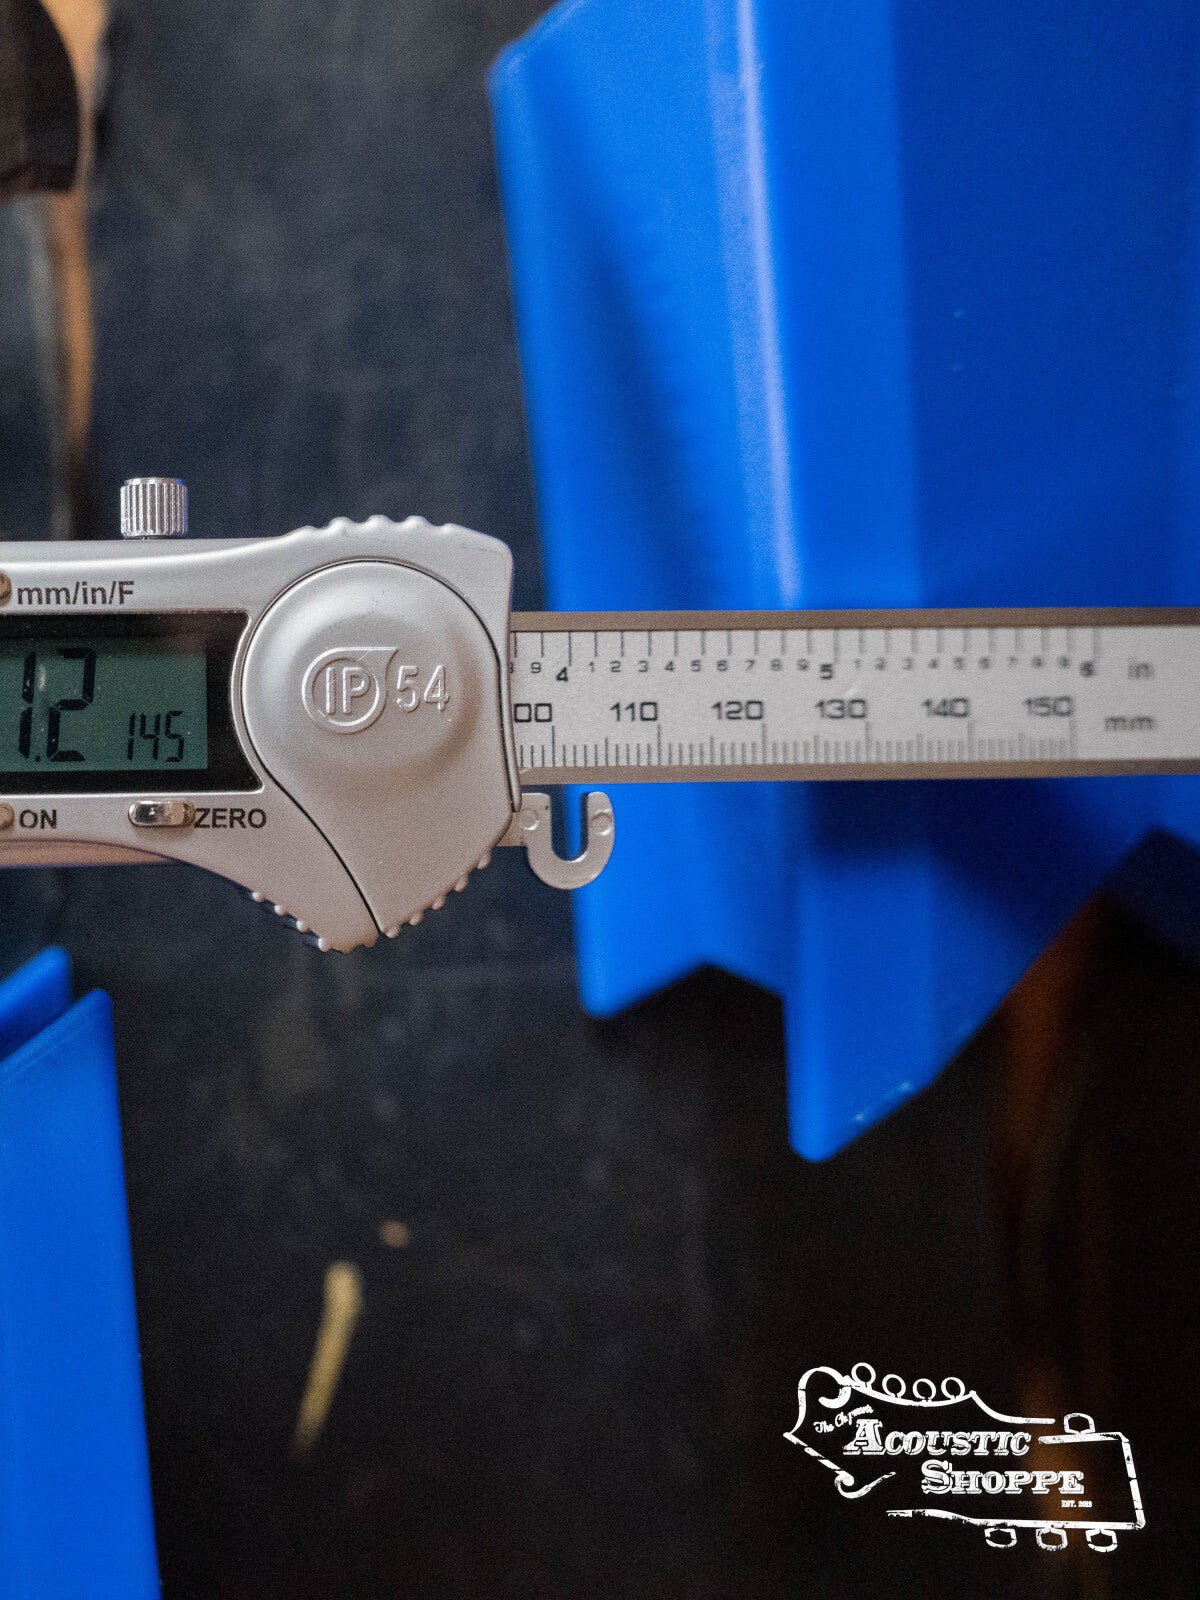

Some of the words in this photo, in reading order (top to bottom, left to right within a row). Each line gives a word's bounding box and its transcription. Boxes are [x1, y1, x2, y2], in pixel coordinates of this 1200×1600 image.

[17, 580, 135, 605] mm/in/F
[530, 661, 542, 675] 9
[555, 666, 569, 683] 4
[588, 661, 596, 673] 1
[609, 659, 622, 674] 2
[638, 659, 650, 674] 3
[664, 660, 675, 672] 4
[820, 663, 833, 680] 5
[324, 665, 371, 716] IP
[396, 664, 450, 713] 54
[513, 702, 554, 724] 00
[609, 701, 659, 722] 110
[711, 699, 764, 721] 120
[815, 698, 868, 720] 130
[921, 697, 970, 719] 140
[1022, 696, 1074, 718] 150
[18, 809, 58, 830] ON
[192, 807, 267, 829] ZERO
